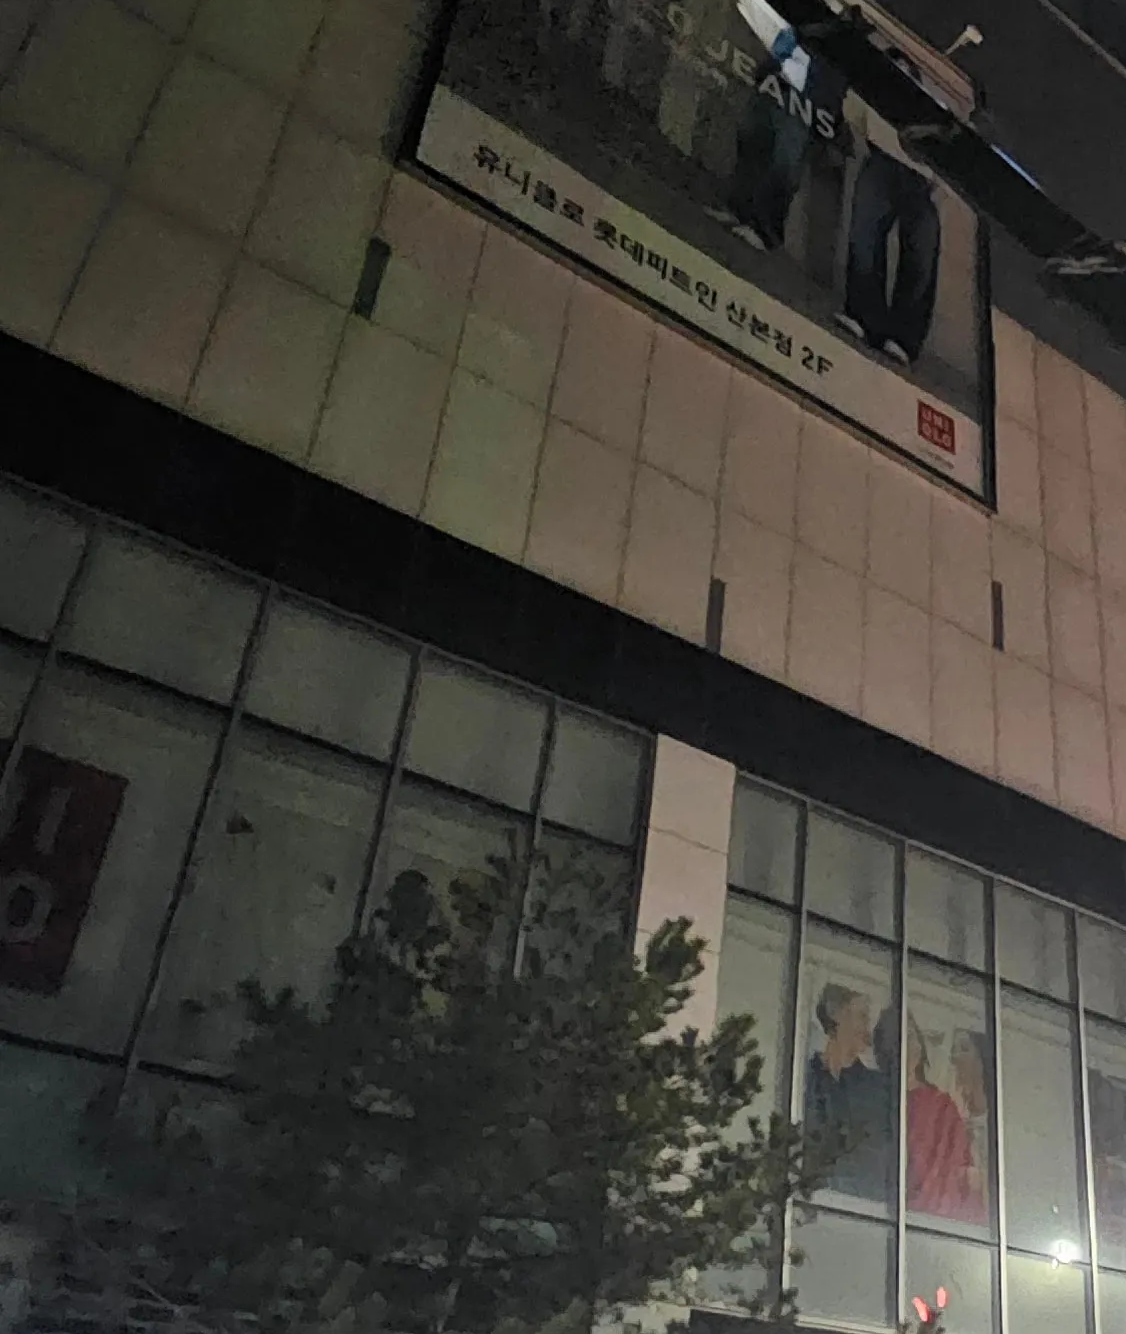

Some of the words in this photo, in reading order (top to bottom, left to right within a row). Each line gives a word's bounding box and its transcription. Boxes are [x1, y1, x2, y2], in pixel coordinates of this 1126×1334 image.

[705, 38, 837, 141] JEANS
[473, 145, 586, 229] 유니클로
[725, 297, 796, 359] 산본점
[800, 344, 835, 379] 2F
